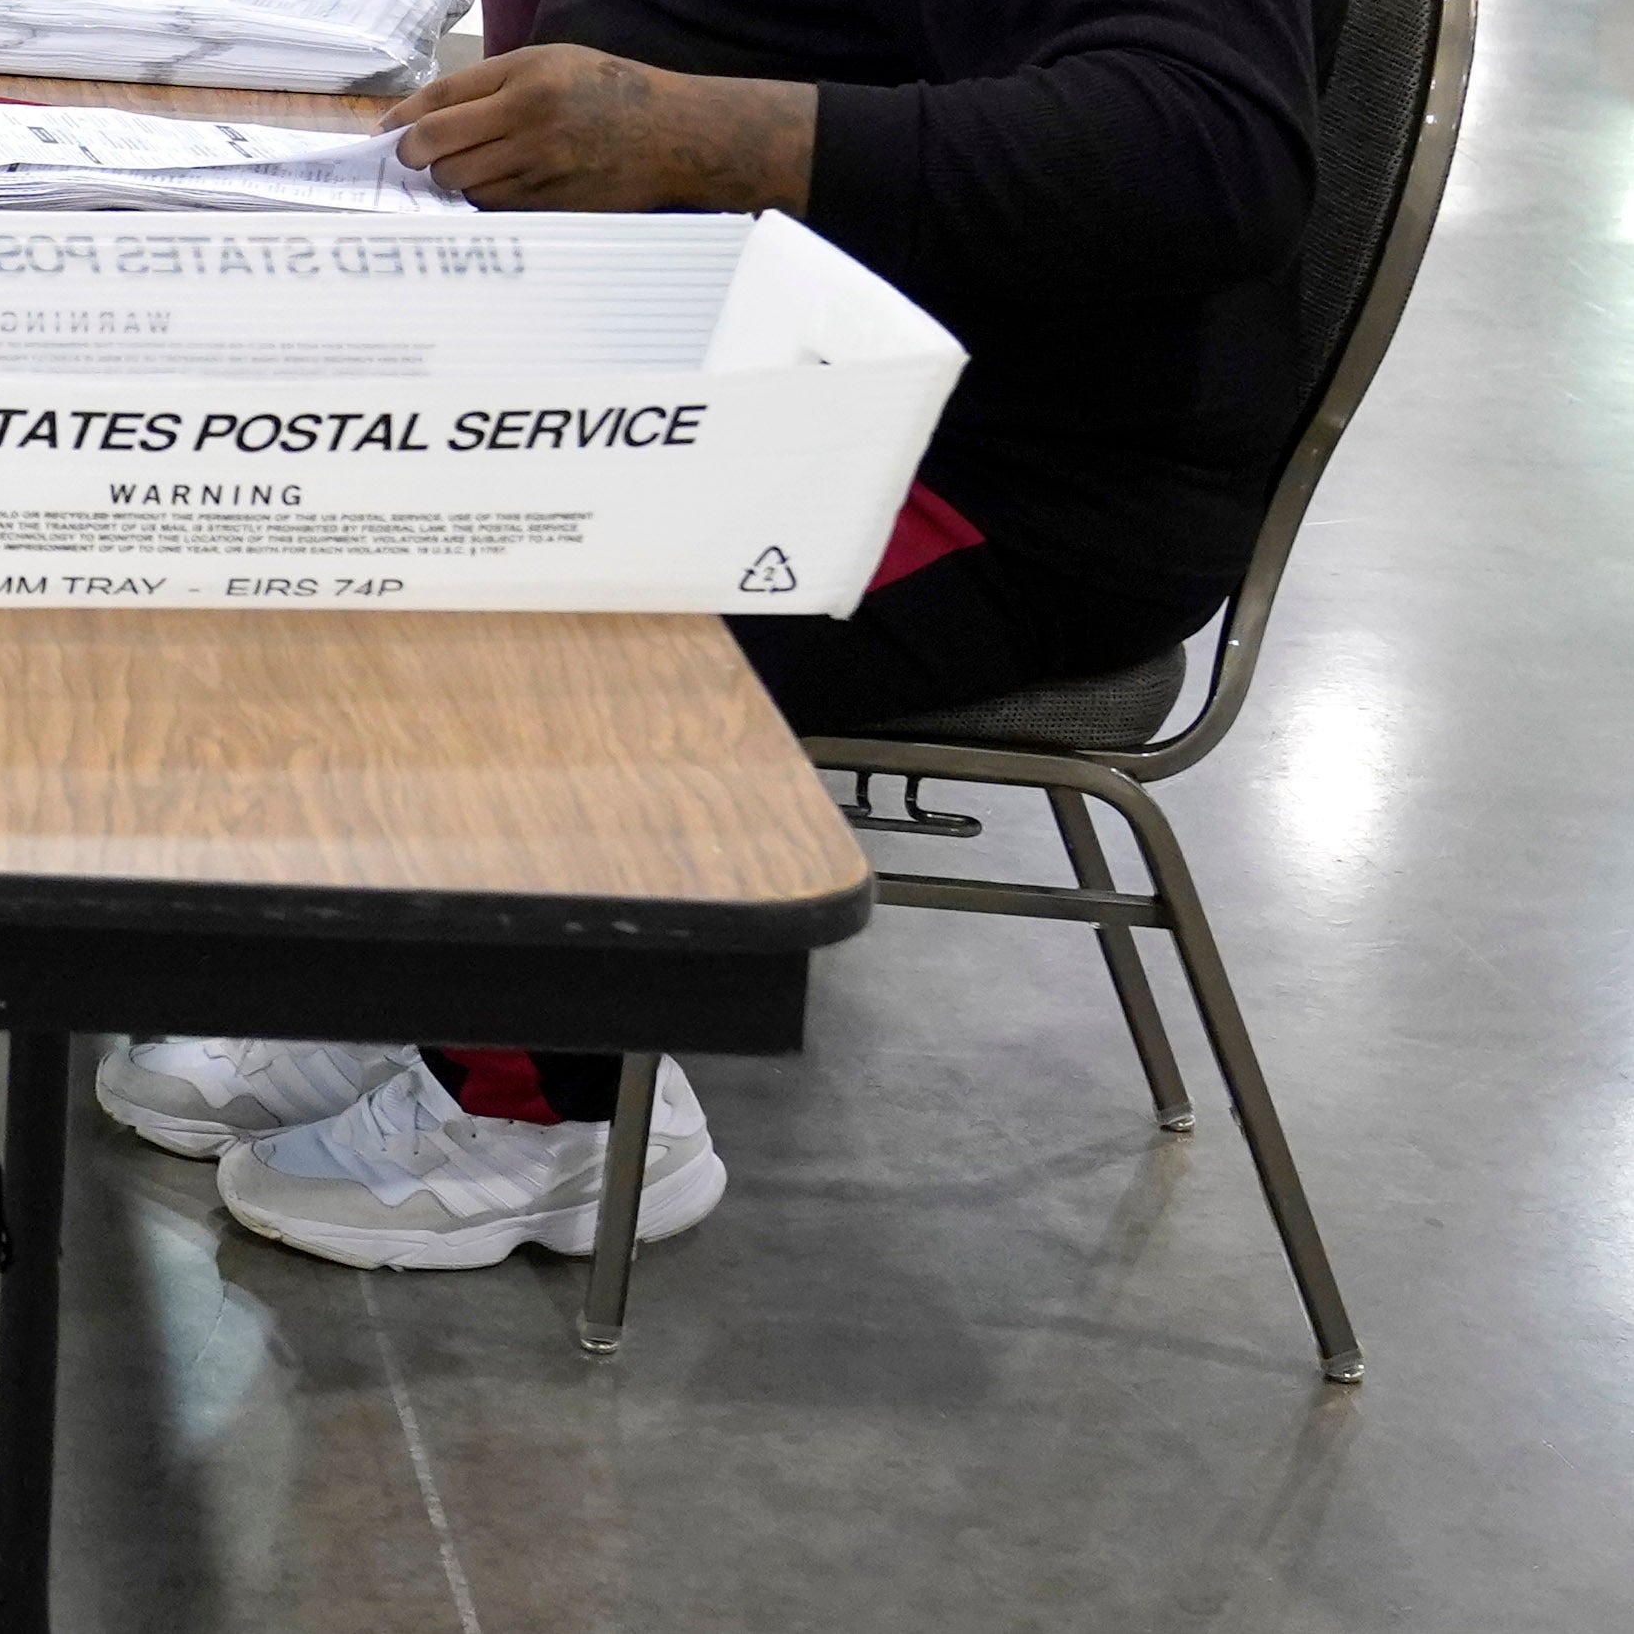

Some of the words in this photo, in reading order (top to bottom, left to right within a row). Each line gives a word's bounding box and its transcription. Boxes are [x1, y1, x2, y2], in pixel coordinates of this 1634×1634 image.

[194, 412, 430, 454] POSTAL
[447, 404, 708, 452] SERVICE
[109, 483, 303, 506] WARNING
[62, 576, 167, 596] TRAY
[225, 578, 319, 597] EIRS
[333, 578, 405, 597] 74P
